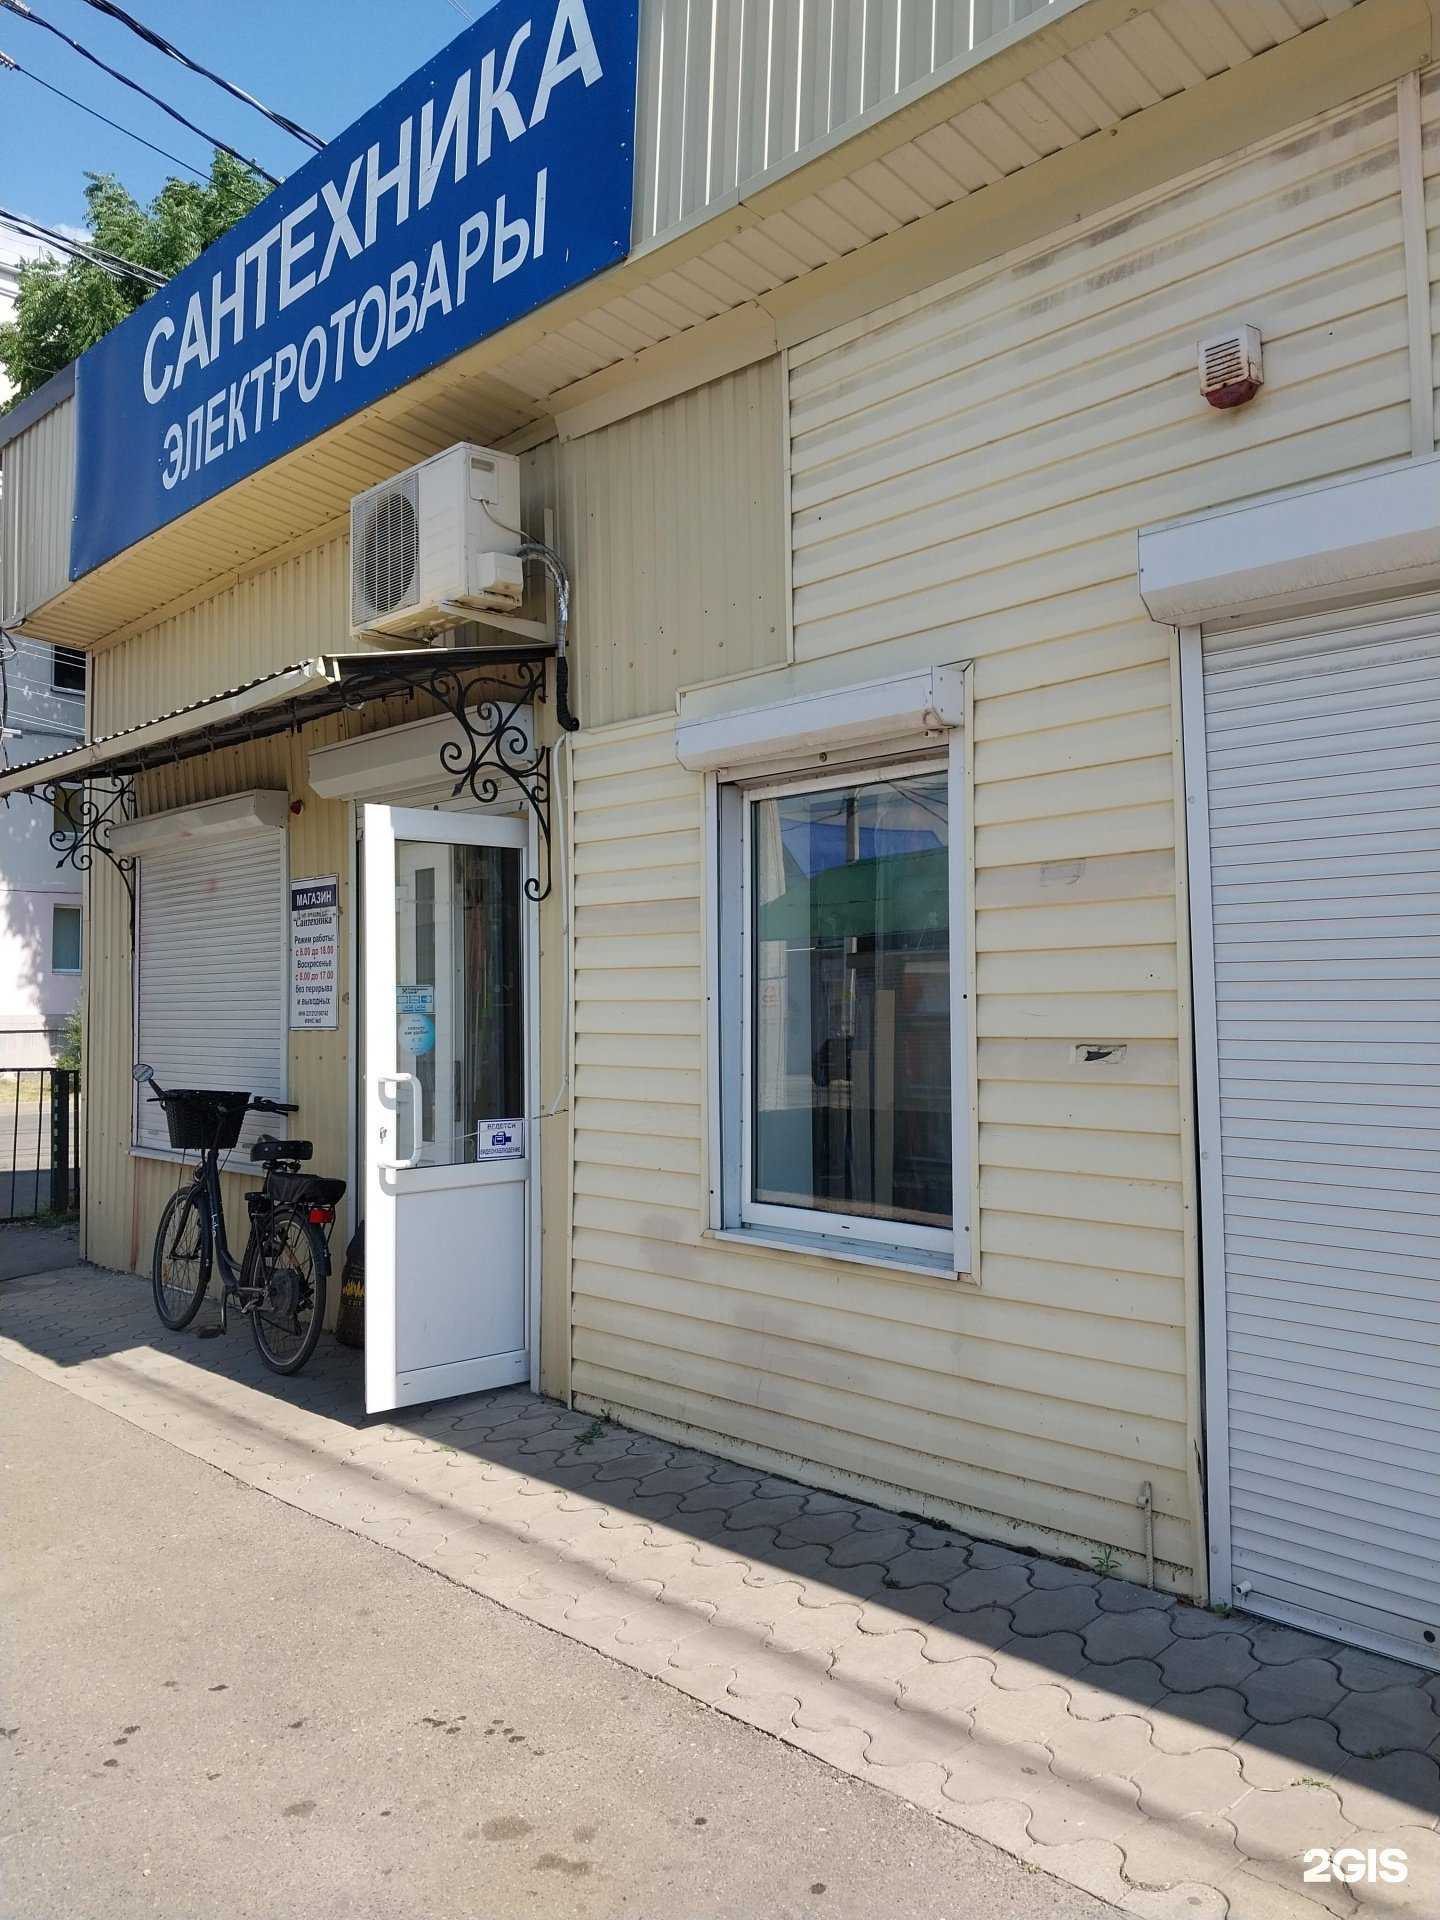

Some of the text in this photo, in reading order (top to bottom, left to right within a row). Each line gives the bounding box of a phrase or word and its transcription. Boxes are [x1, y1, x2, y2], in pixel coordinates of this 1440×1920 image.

[142, 0, 603, 405] САНТЕХНИКА
[161, 168, 548, 490] ЭЛЕКТРОТОВАРЫ
[296, 889, 332, 907] МАГАЗИН
[311, 948, 319, 957] до
[297, 959, 332, 970] Воскресенье
[311, 973, 319, 981] до
[305, 985, 333, 995] перерыва
[301, 997, 331, 1005] выходных
